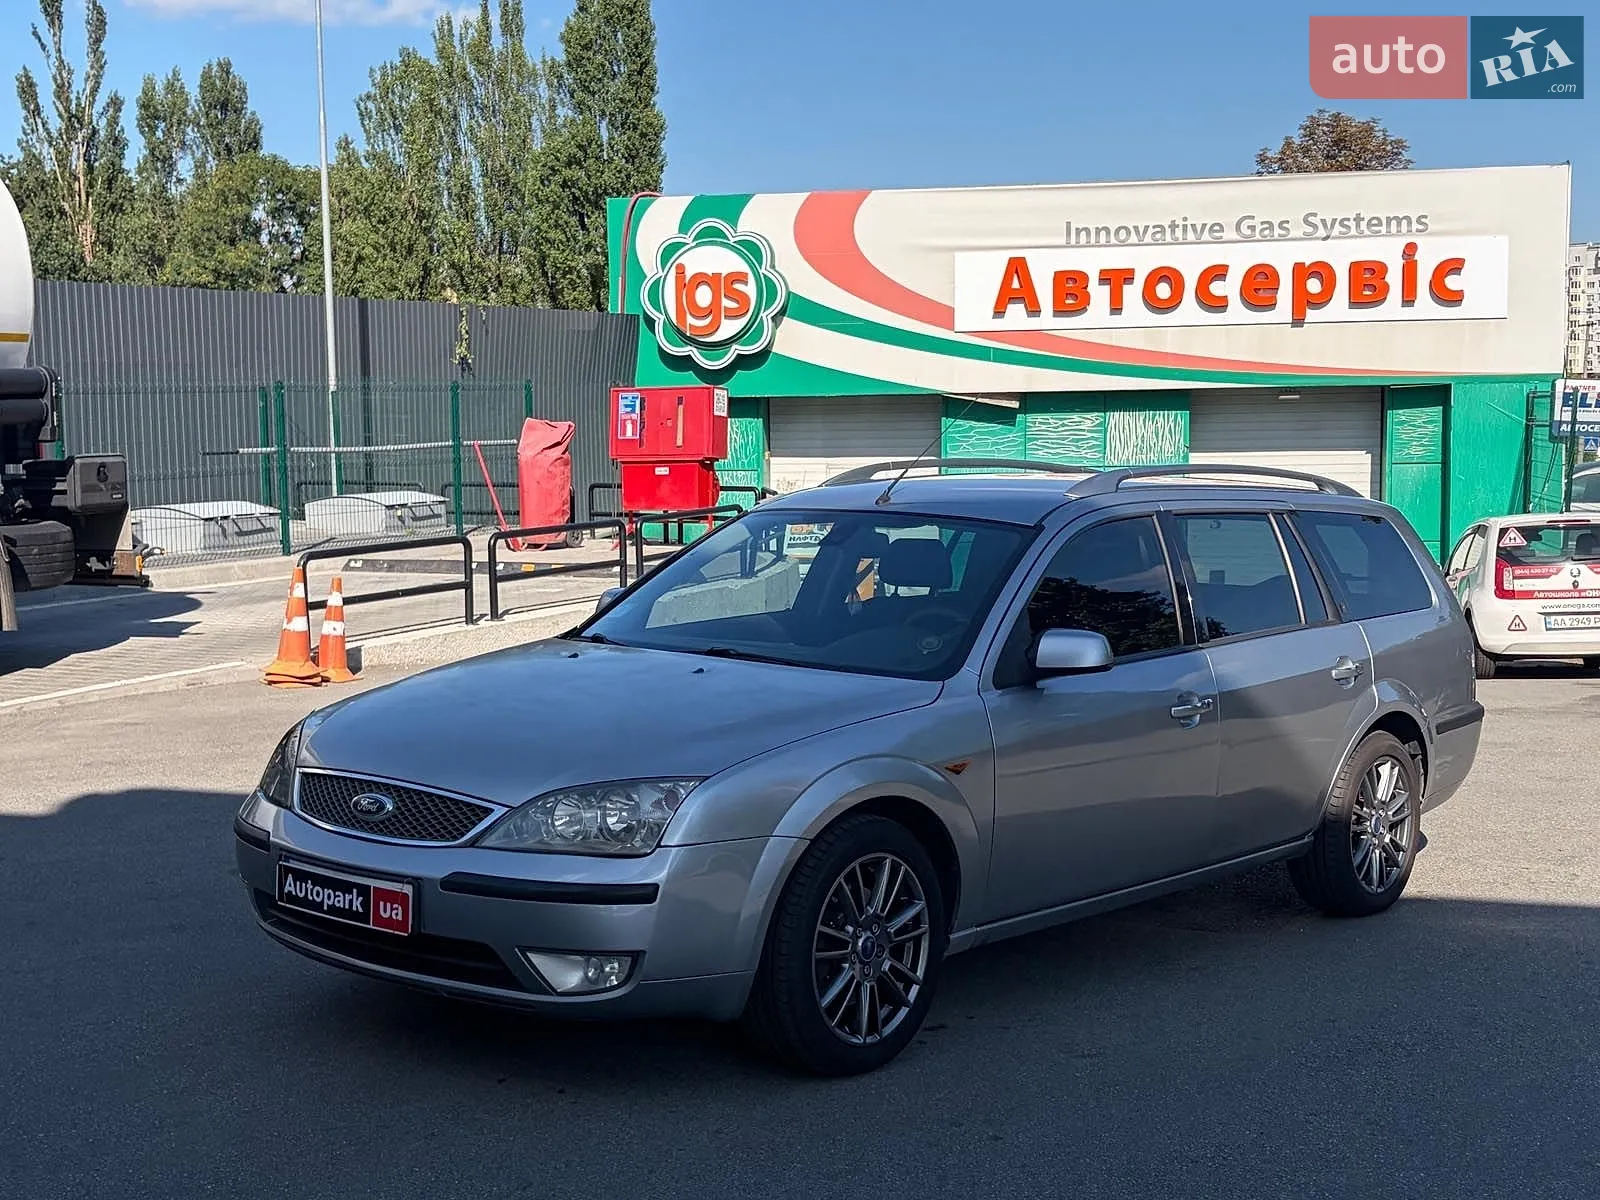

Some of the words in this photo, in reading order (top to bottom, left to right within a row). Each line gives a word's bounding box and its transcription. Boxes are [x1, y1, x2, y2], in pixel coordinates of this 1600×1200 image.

[1065, 219, 1225, 245] Innovative
[1235, 215, 1290, 240] Gas
[1302, 211, 1430, 241] Systems
[674, 263, 751, 336] igs
[993, 241, 1466, 323] Автосервіс
[1569, 616, 1591, 626] 2949
[357, 798, 380, 811] Ford
[284, 873, 364, 912] Autopark
[379, 901, 403, 920] ua
